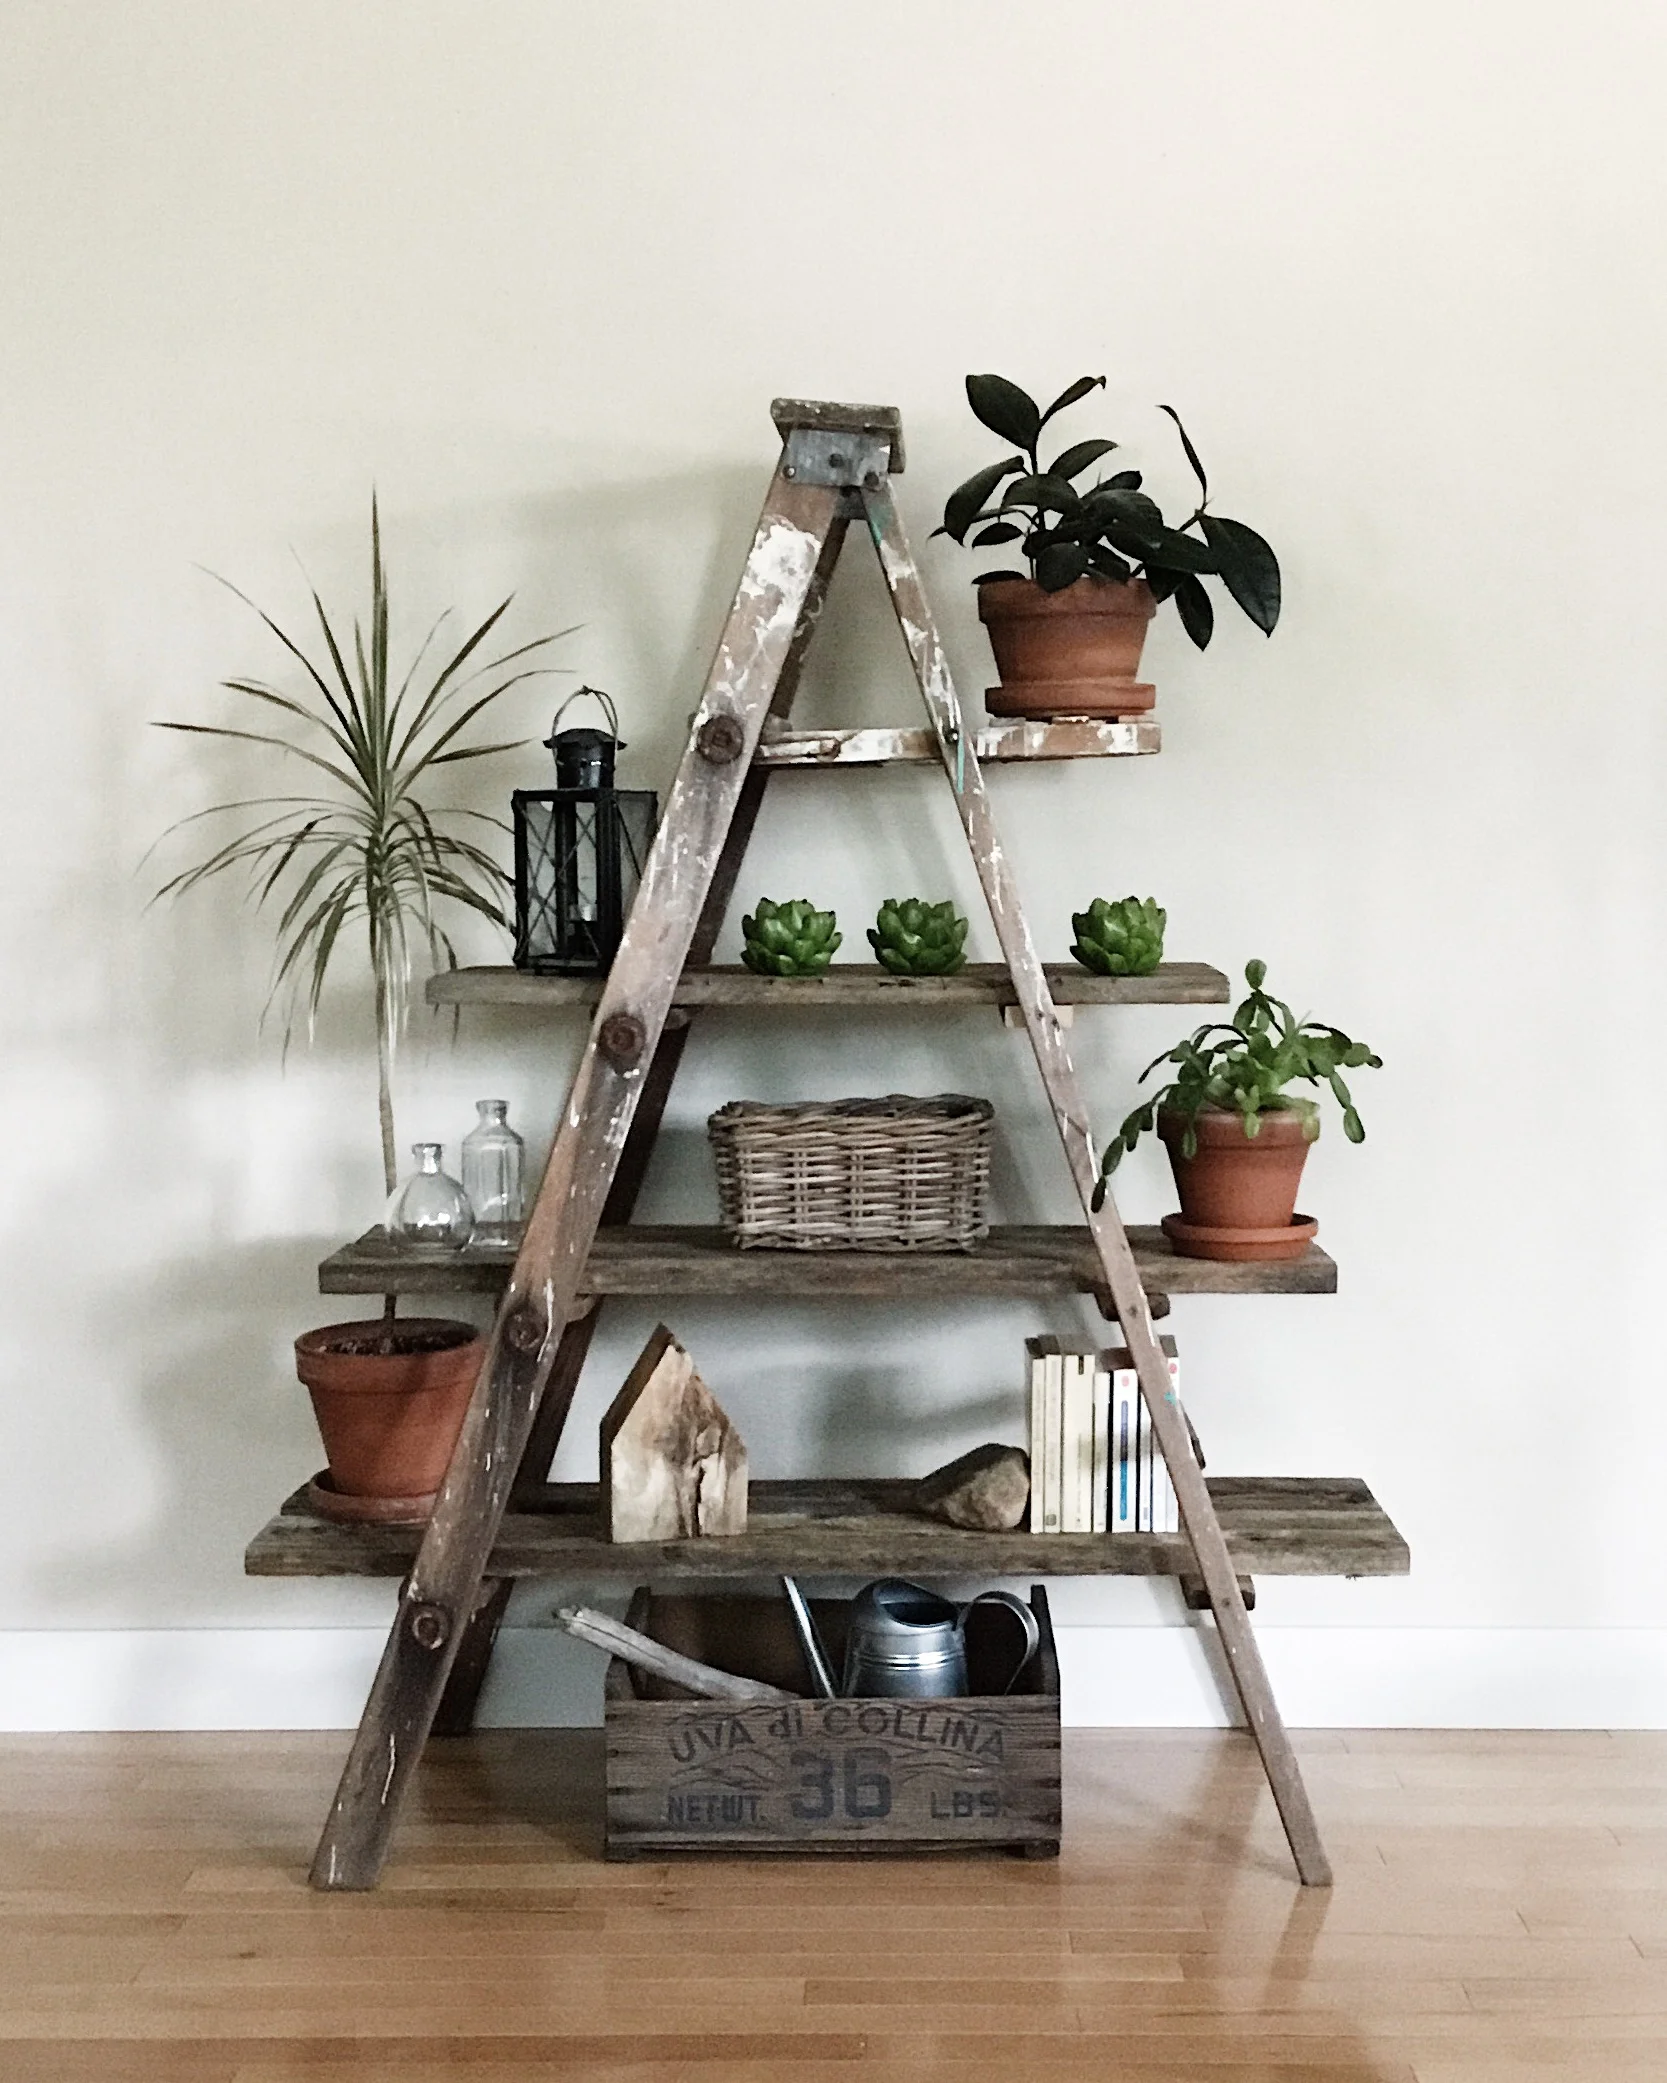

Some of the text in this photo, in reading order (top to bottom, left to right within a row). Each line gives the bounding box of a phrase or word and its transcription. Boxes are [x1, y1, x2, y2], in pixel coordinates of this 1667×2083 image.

[668, 1705, 1003, 1762] UVA di COLLINA
[790, 1746, 893, 1819] 36
